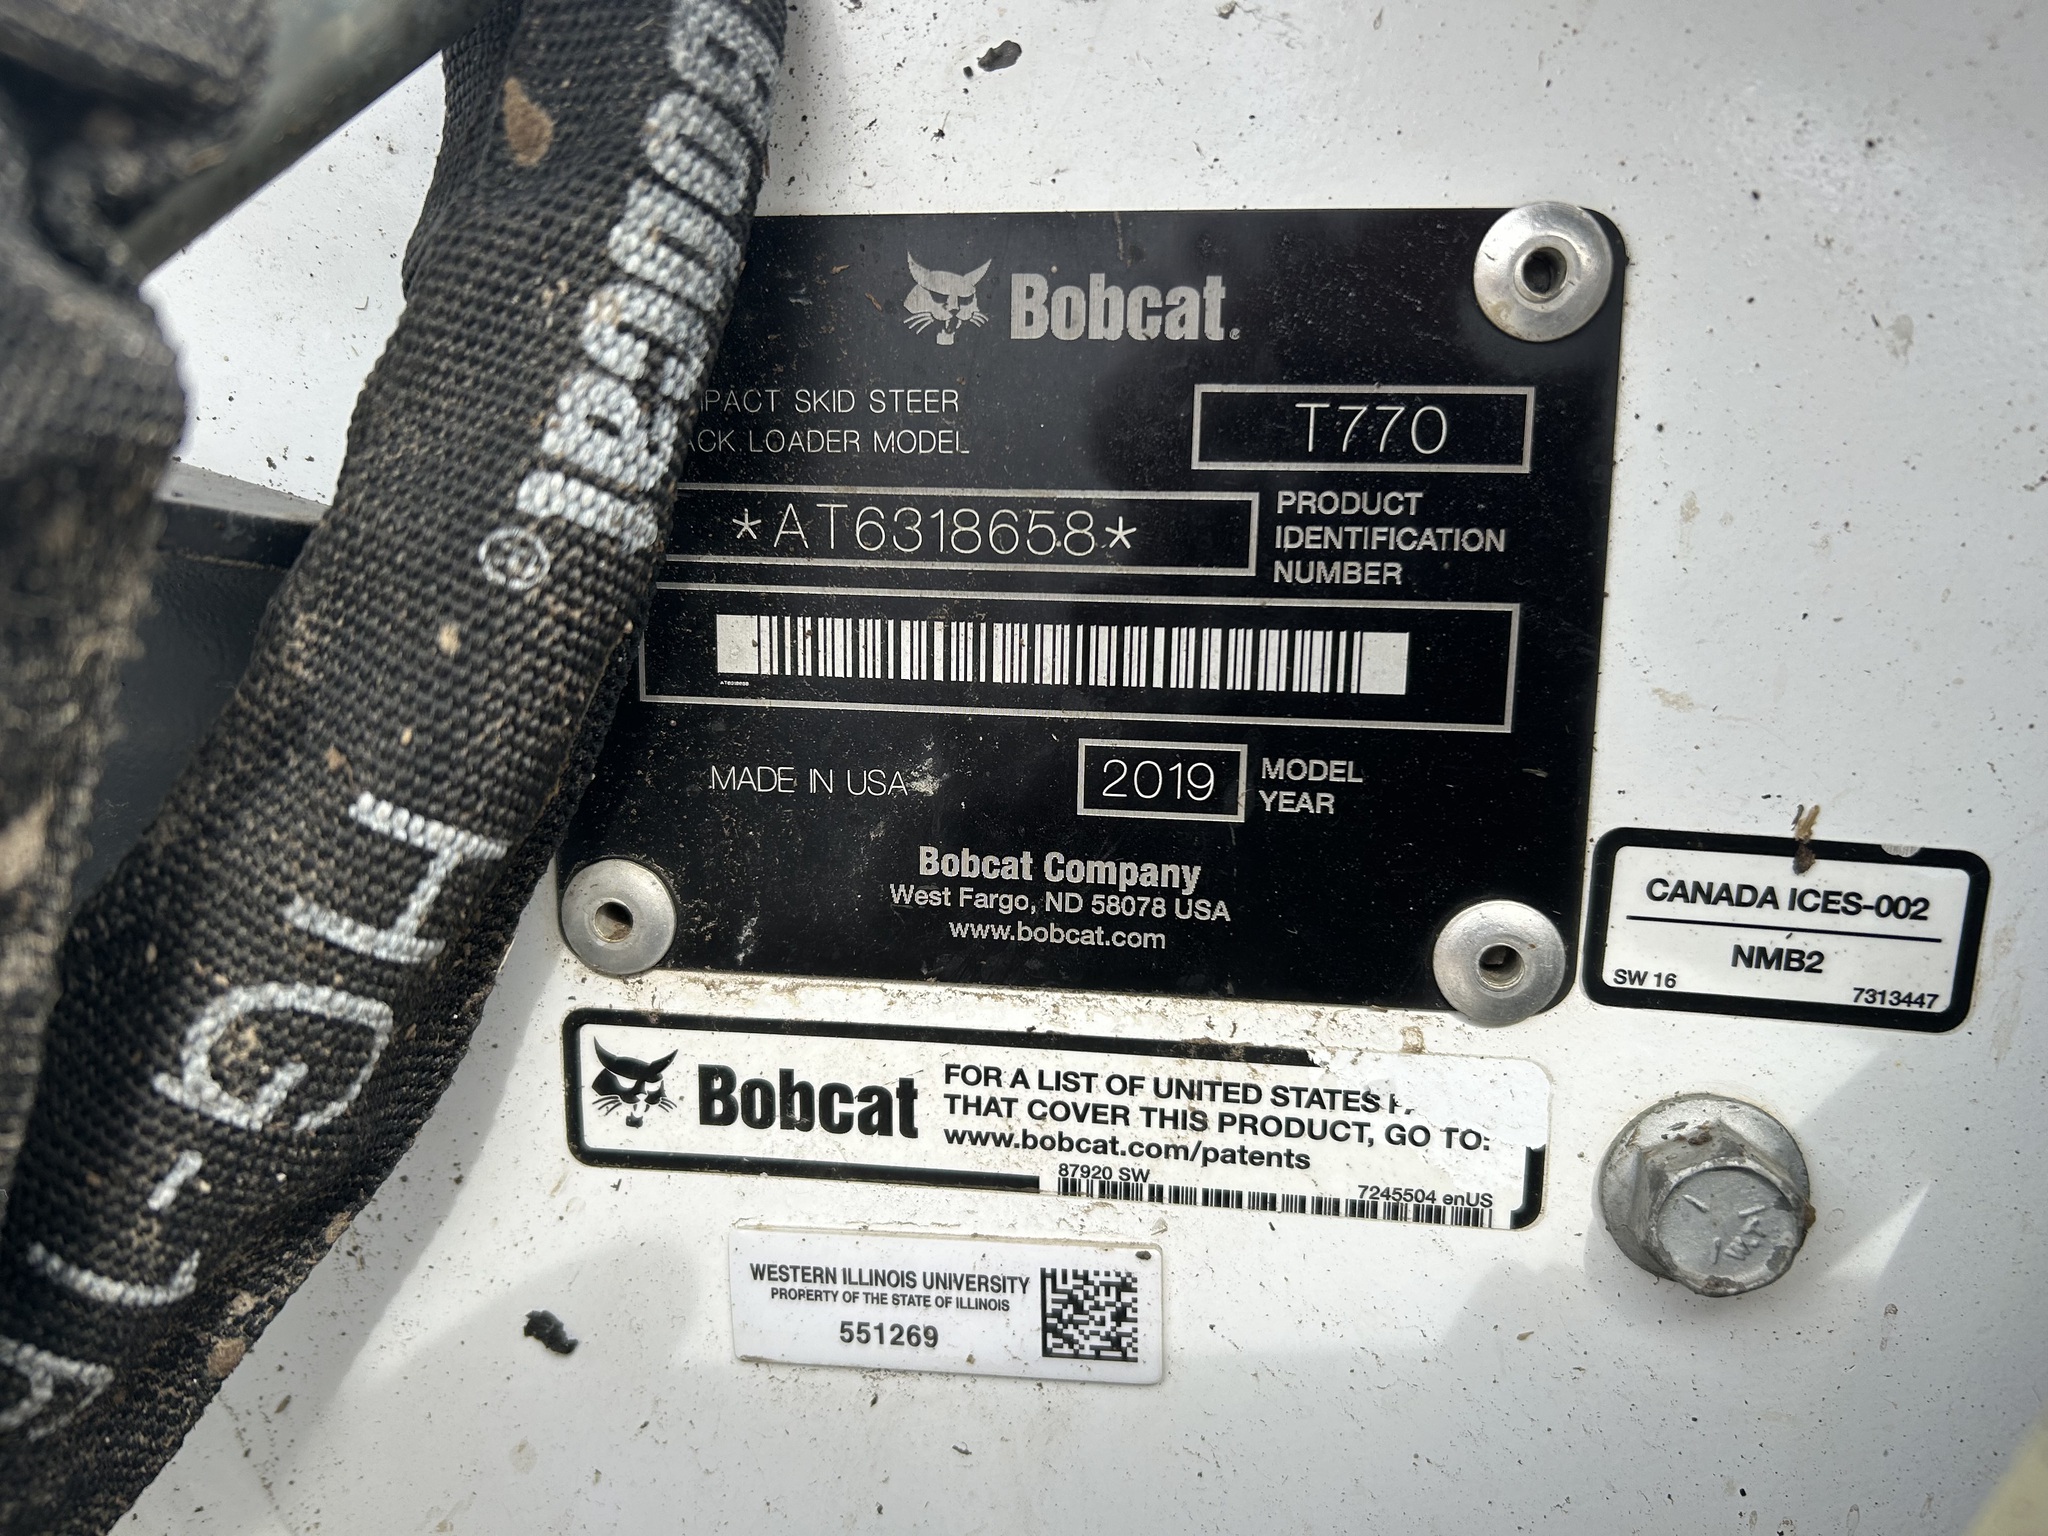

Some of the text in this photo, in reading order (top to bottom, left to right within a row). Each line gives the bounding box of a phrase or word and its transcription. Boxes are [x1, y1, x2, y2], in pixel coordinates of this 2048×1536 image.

[1010, 272, 1226, 342] Bobcat
[700, 388, 959, 413] PACT SKID STEER
[749, 428, 861, 454] LOADER
[873, 430, 970, 454] MODEL
[1295, 403, 1448, 455] T770
[1276, 490, 1424, 516] PRODUCT
[1275, 526, 1506, 553] IDENTIFICATION
[1273, 560, 1403, 585] NUMBER
[711, 765, 909, 796] MADE IN USA
[1101, 758, 1215, 801] 2019
[1261, 757, 1364, 783] MODEL
[1258, 790, 1335, 814] YEAR
[919, 845, 1202, 895] Bobcat Company
[889, 883, 1232, 922] West Fargo, ND 58078 USA
[1645, 877, 1931, 921] CANADA ICES-002
[948, 920, 1167, 949] www.bobcat.com
[1731, 943, 1825, 974] NMB2
[1613, 968, 1677, 989] SW 16
[1852, 987, 1939, 1010] 7313447
[698, 1063, 919, 1139] Bobcat
[944, 1063, 1003, 1088] FOR
[1009, 1067, 1030, 1090] A
[1037, 1069, 1099, 1094] LIST
[1105, 1073, 1146, 1097] OF
[1152, 1076, 1263, 1105] UNITED
[1269, 1084, 1381, 1113] STATES
[943, 1093, 1491, 1151] THAT COVER THIS PRODUCT, GO TO:
[943, 1128, 1311, 1170] www.bobcat.com/patents
[1058, 1162, 1151, 1183] 87920 SW
[1357, 1184, 1494, 1208] 7245504 enUS
[749, 1262, 1031, 1295] WESTERN ILLINOIS UNIVERSITY
[770, 1287, 1011, 1312] PROPERTY OF THE STATE OF ILLINOIS
[839, 1320, 939, 1349] 551269
